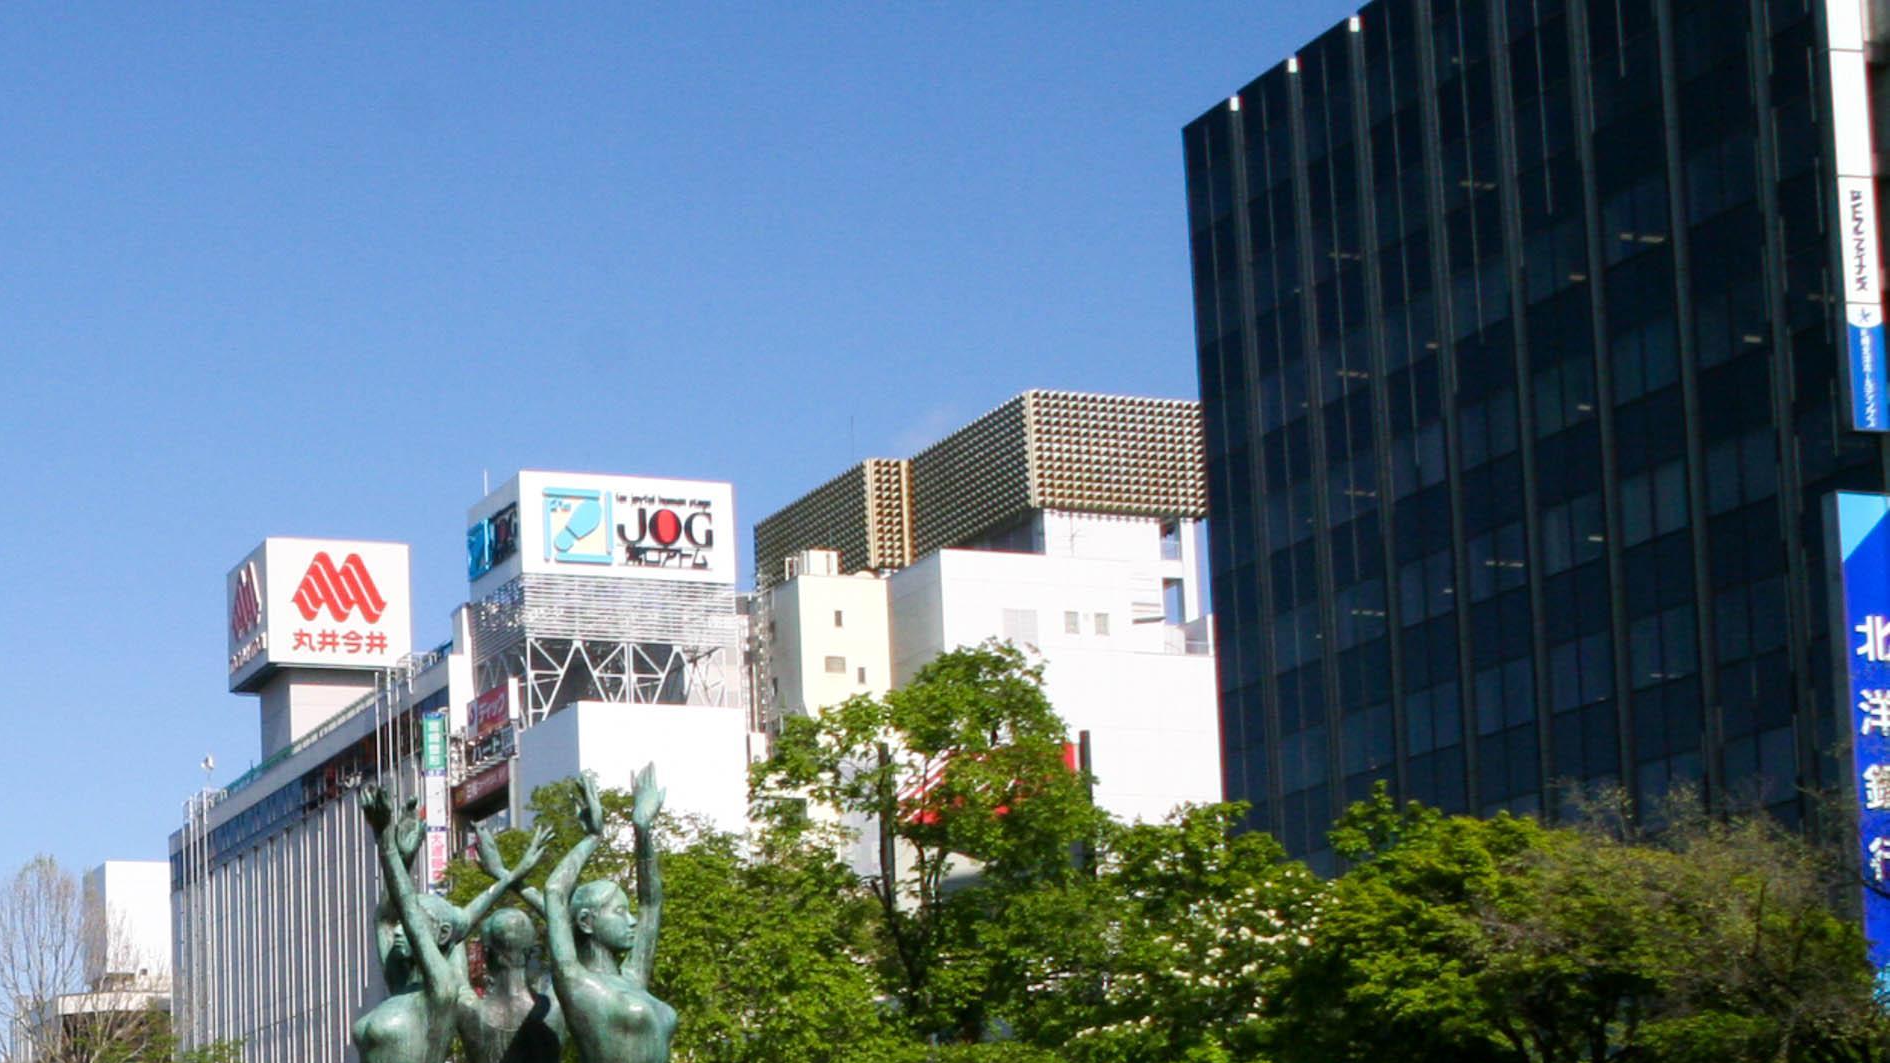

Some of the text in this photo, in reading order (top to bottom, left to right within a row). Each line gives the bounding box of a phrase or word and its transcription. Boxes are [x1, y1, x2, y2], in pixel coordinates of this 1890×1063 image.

[616, 507, 713, 549] JOG
[292, 629, 388, 654] 丸井今井
